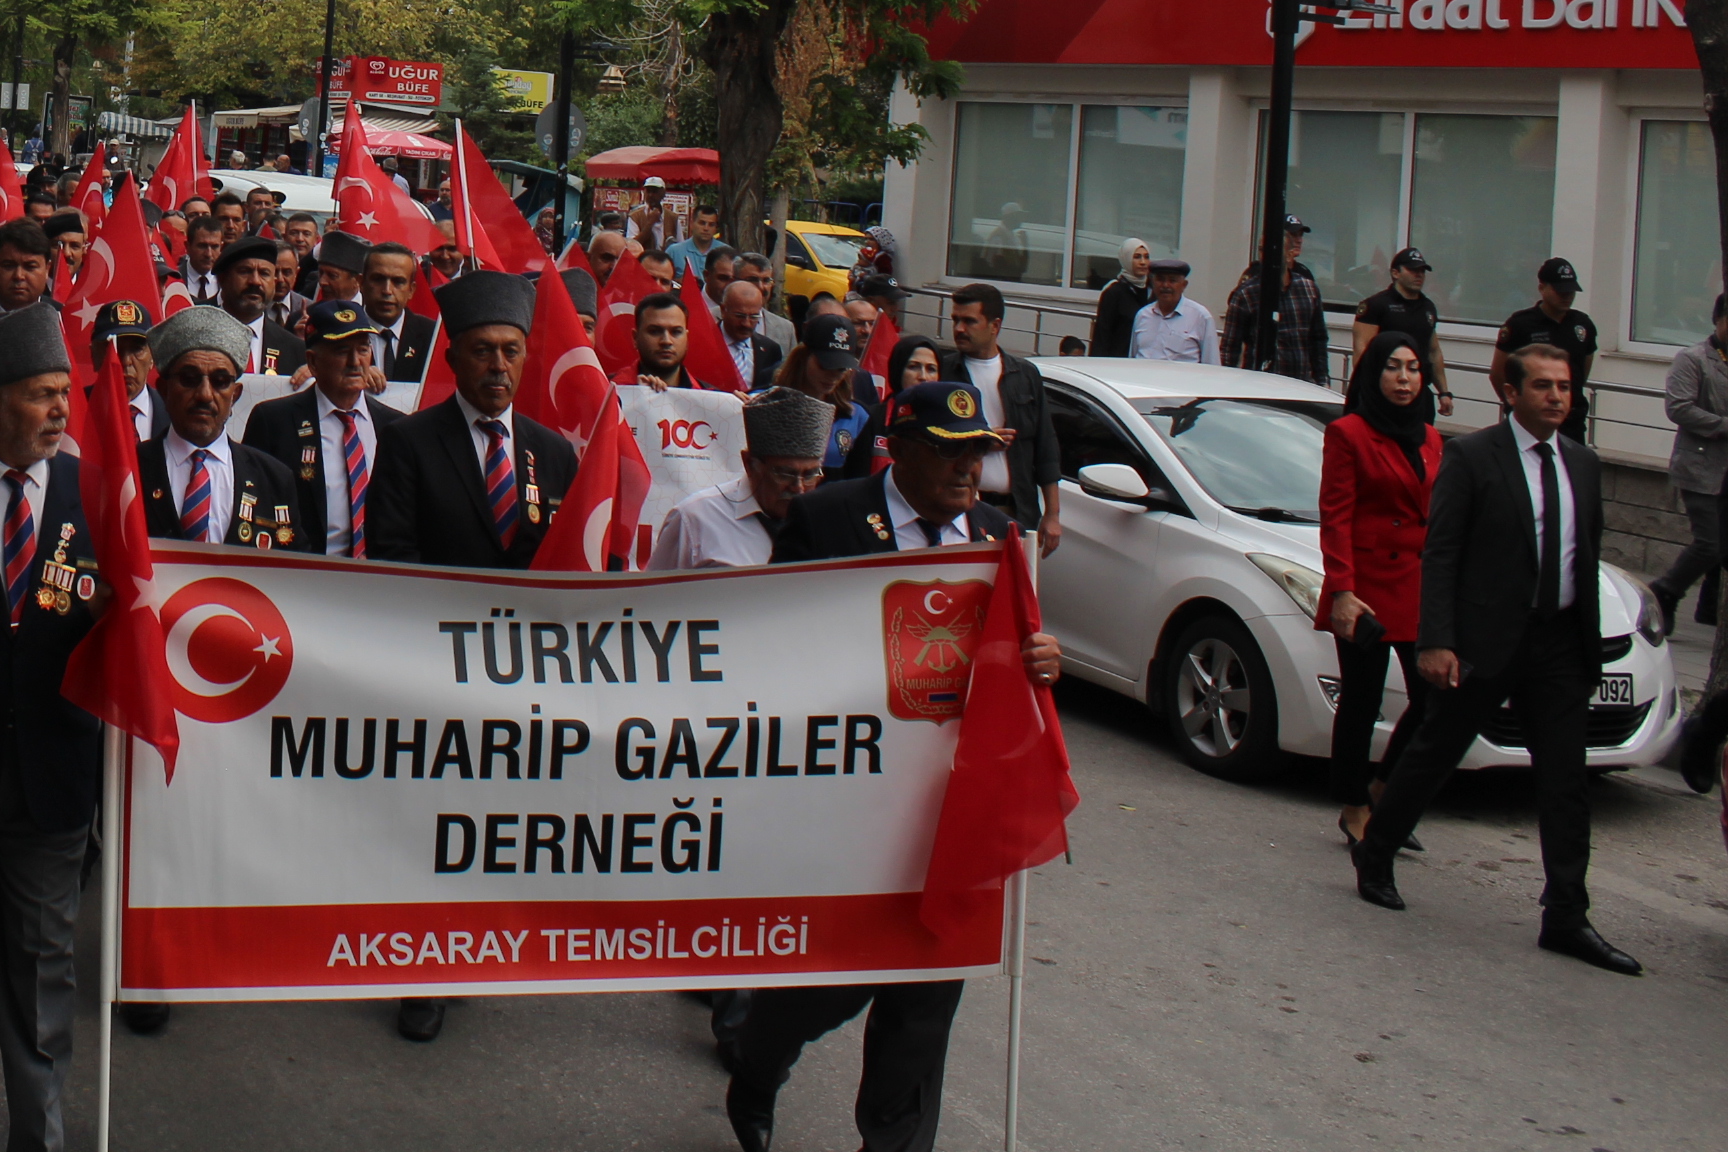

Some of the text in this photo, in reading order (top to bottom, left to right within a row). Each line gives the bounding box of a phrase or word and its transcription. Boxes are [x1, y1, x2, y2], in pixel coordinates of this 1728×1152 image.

[388, 64, 439, 81] UĞUR
[397, 81, 430, 94] BÜFE
[438, 606, 724, 684] TÜRKİYE
[906, 676, 953, 691] MUHARİP
[1599, 679, 1630, 703] 092
[269, 701, 883, 781] MUHARİP GAZİLER
[433, 797, 724, 875] DERNEĞİ
[326, 915, 809, 967] AKSARAY TEMSİLCİLİĞİ
